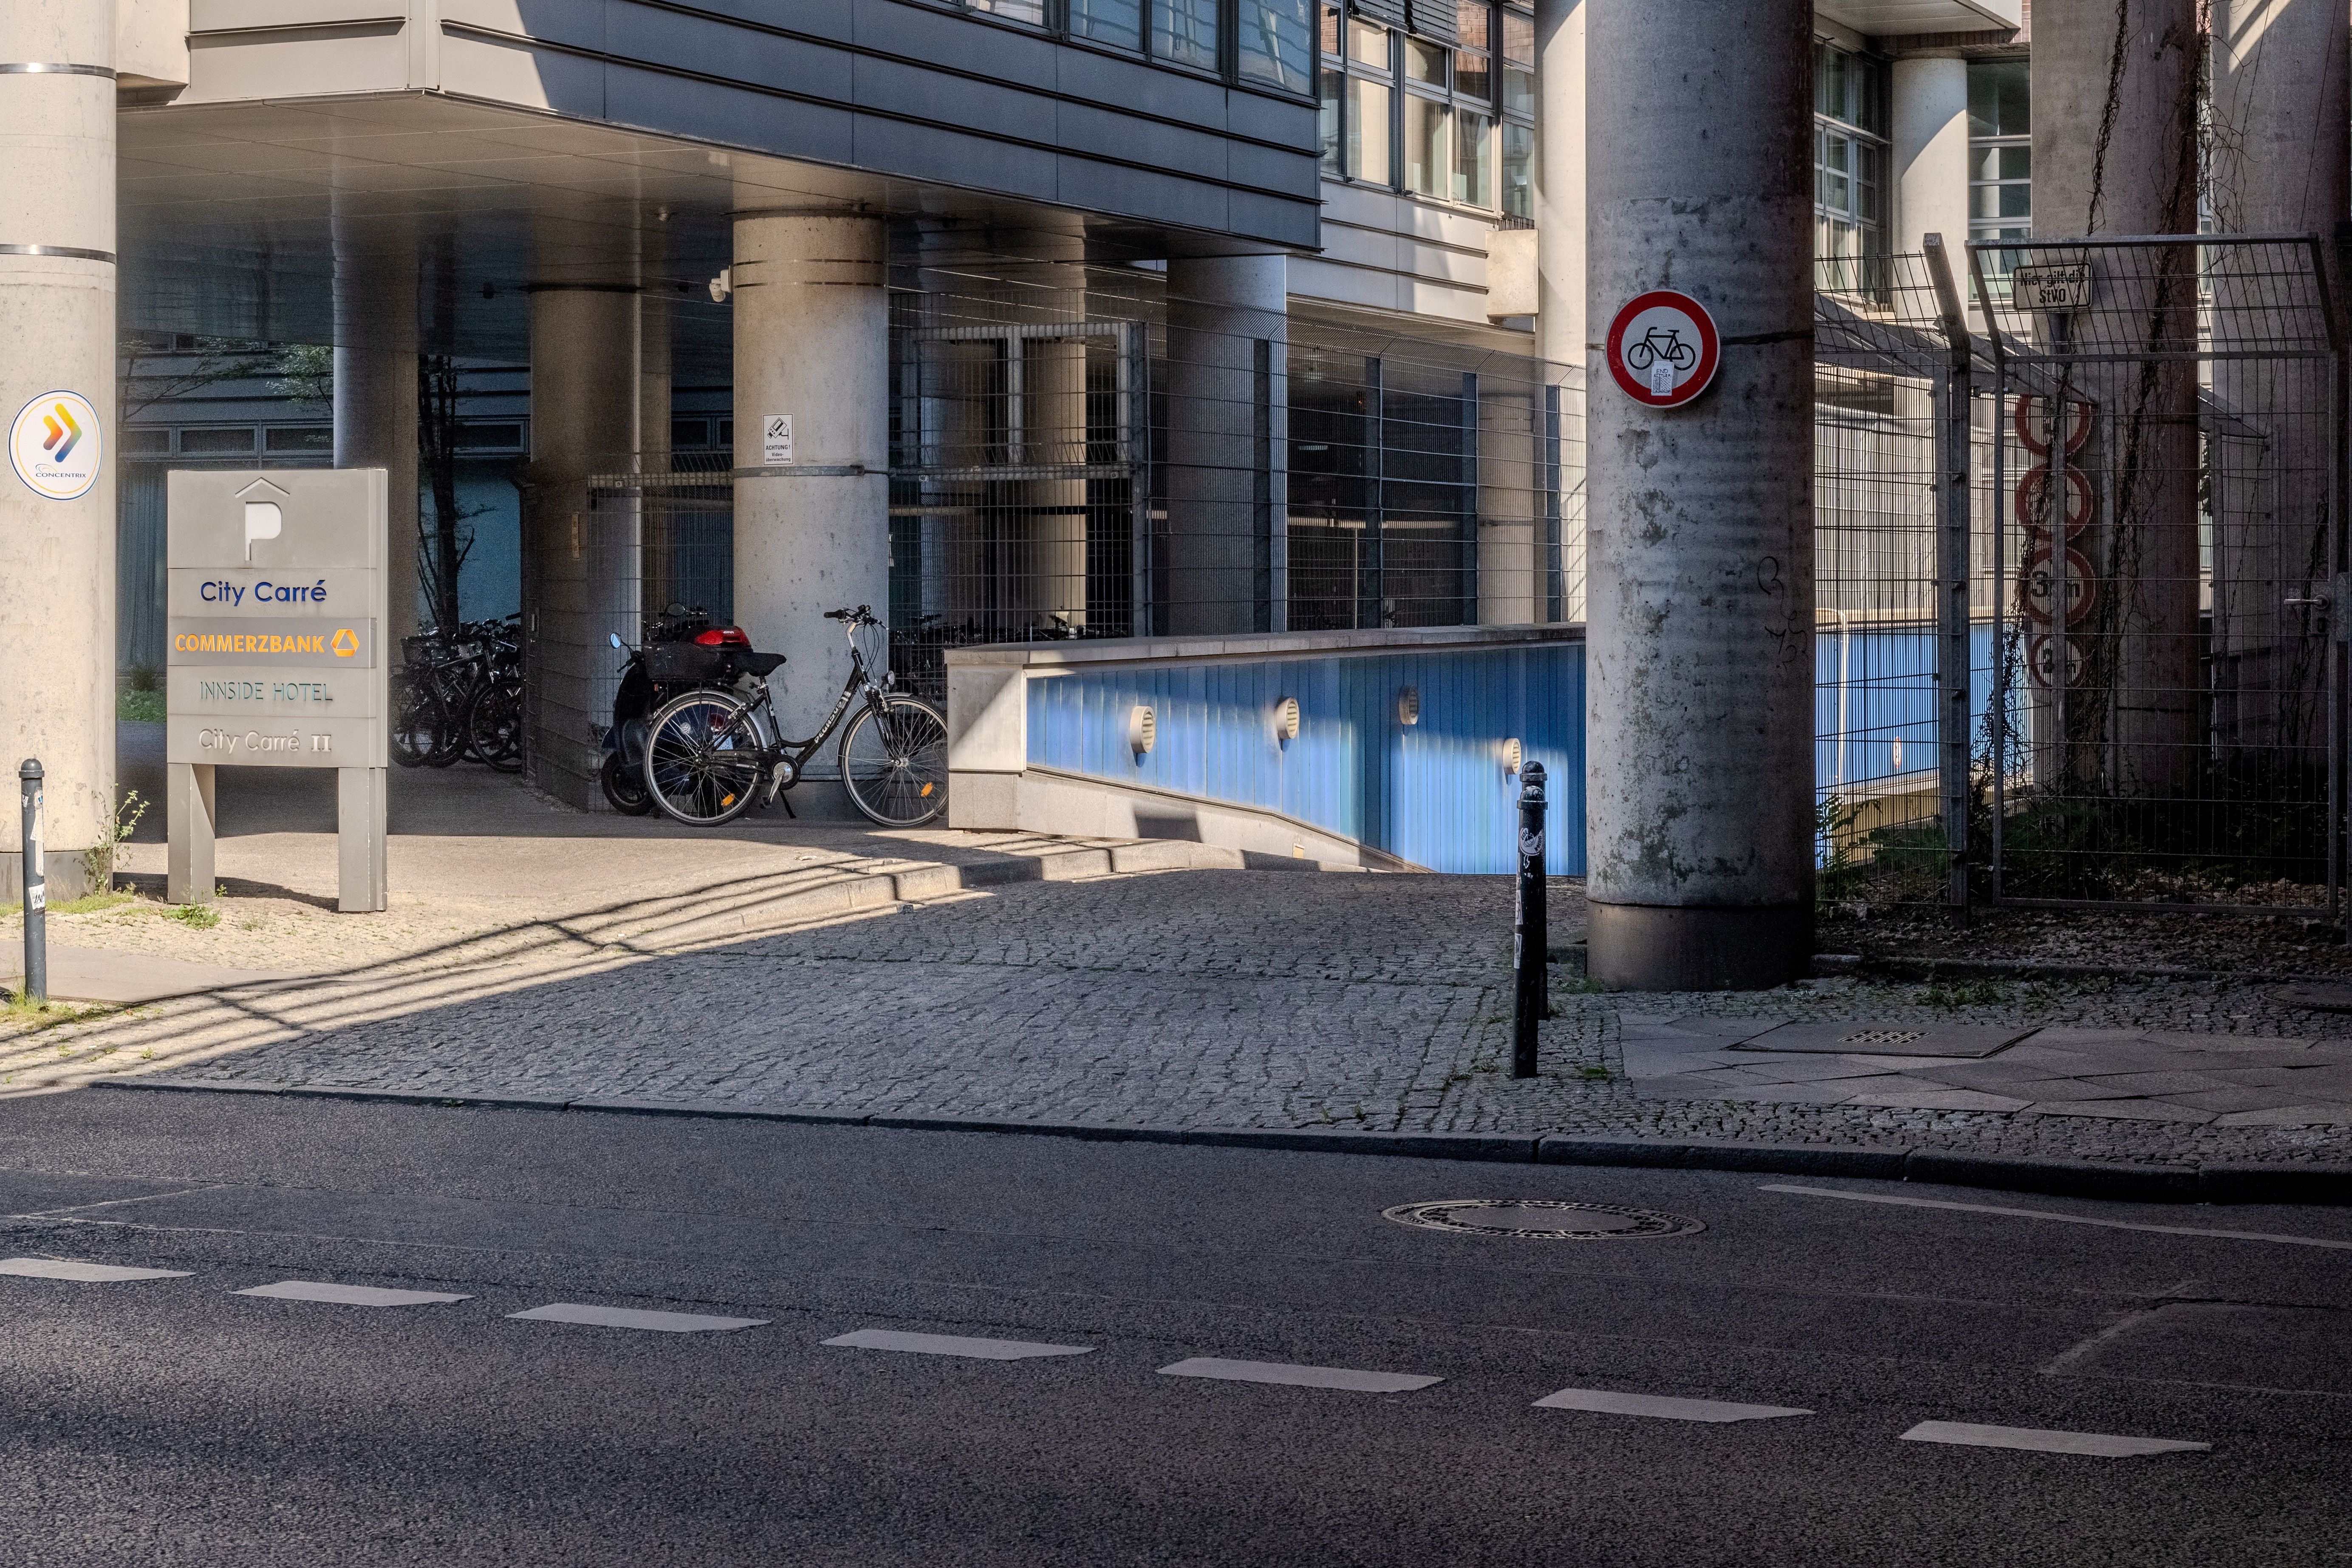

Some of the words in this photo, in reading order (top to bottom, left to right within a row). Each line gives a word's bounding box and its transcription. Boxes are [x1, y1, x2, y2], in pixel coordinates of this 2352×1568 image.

[2047, 270, 2065, 288] gilt
[2039, 288, 2066, 303] StVO
[245, 501, 283, 561] P
[201, 581, 246, 607] City
[254, 579, 327, 602] Carré
[175, 633, 325, 653] COMMERZBANK
[200, 681, 264, 700] INNSIDE
[273, 683, 333, 702] HOTEL
[814, 701, 842, 743] PEGASUS
[199, 728, 241, 754] City
[245, 729, 300, 752] Carré
[311, 734, 332, 752] II
